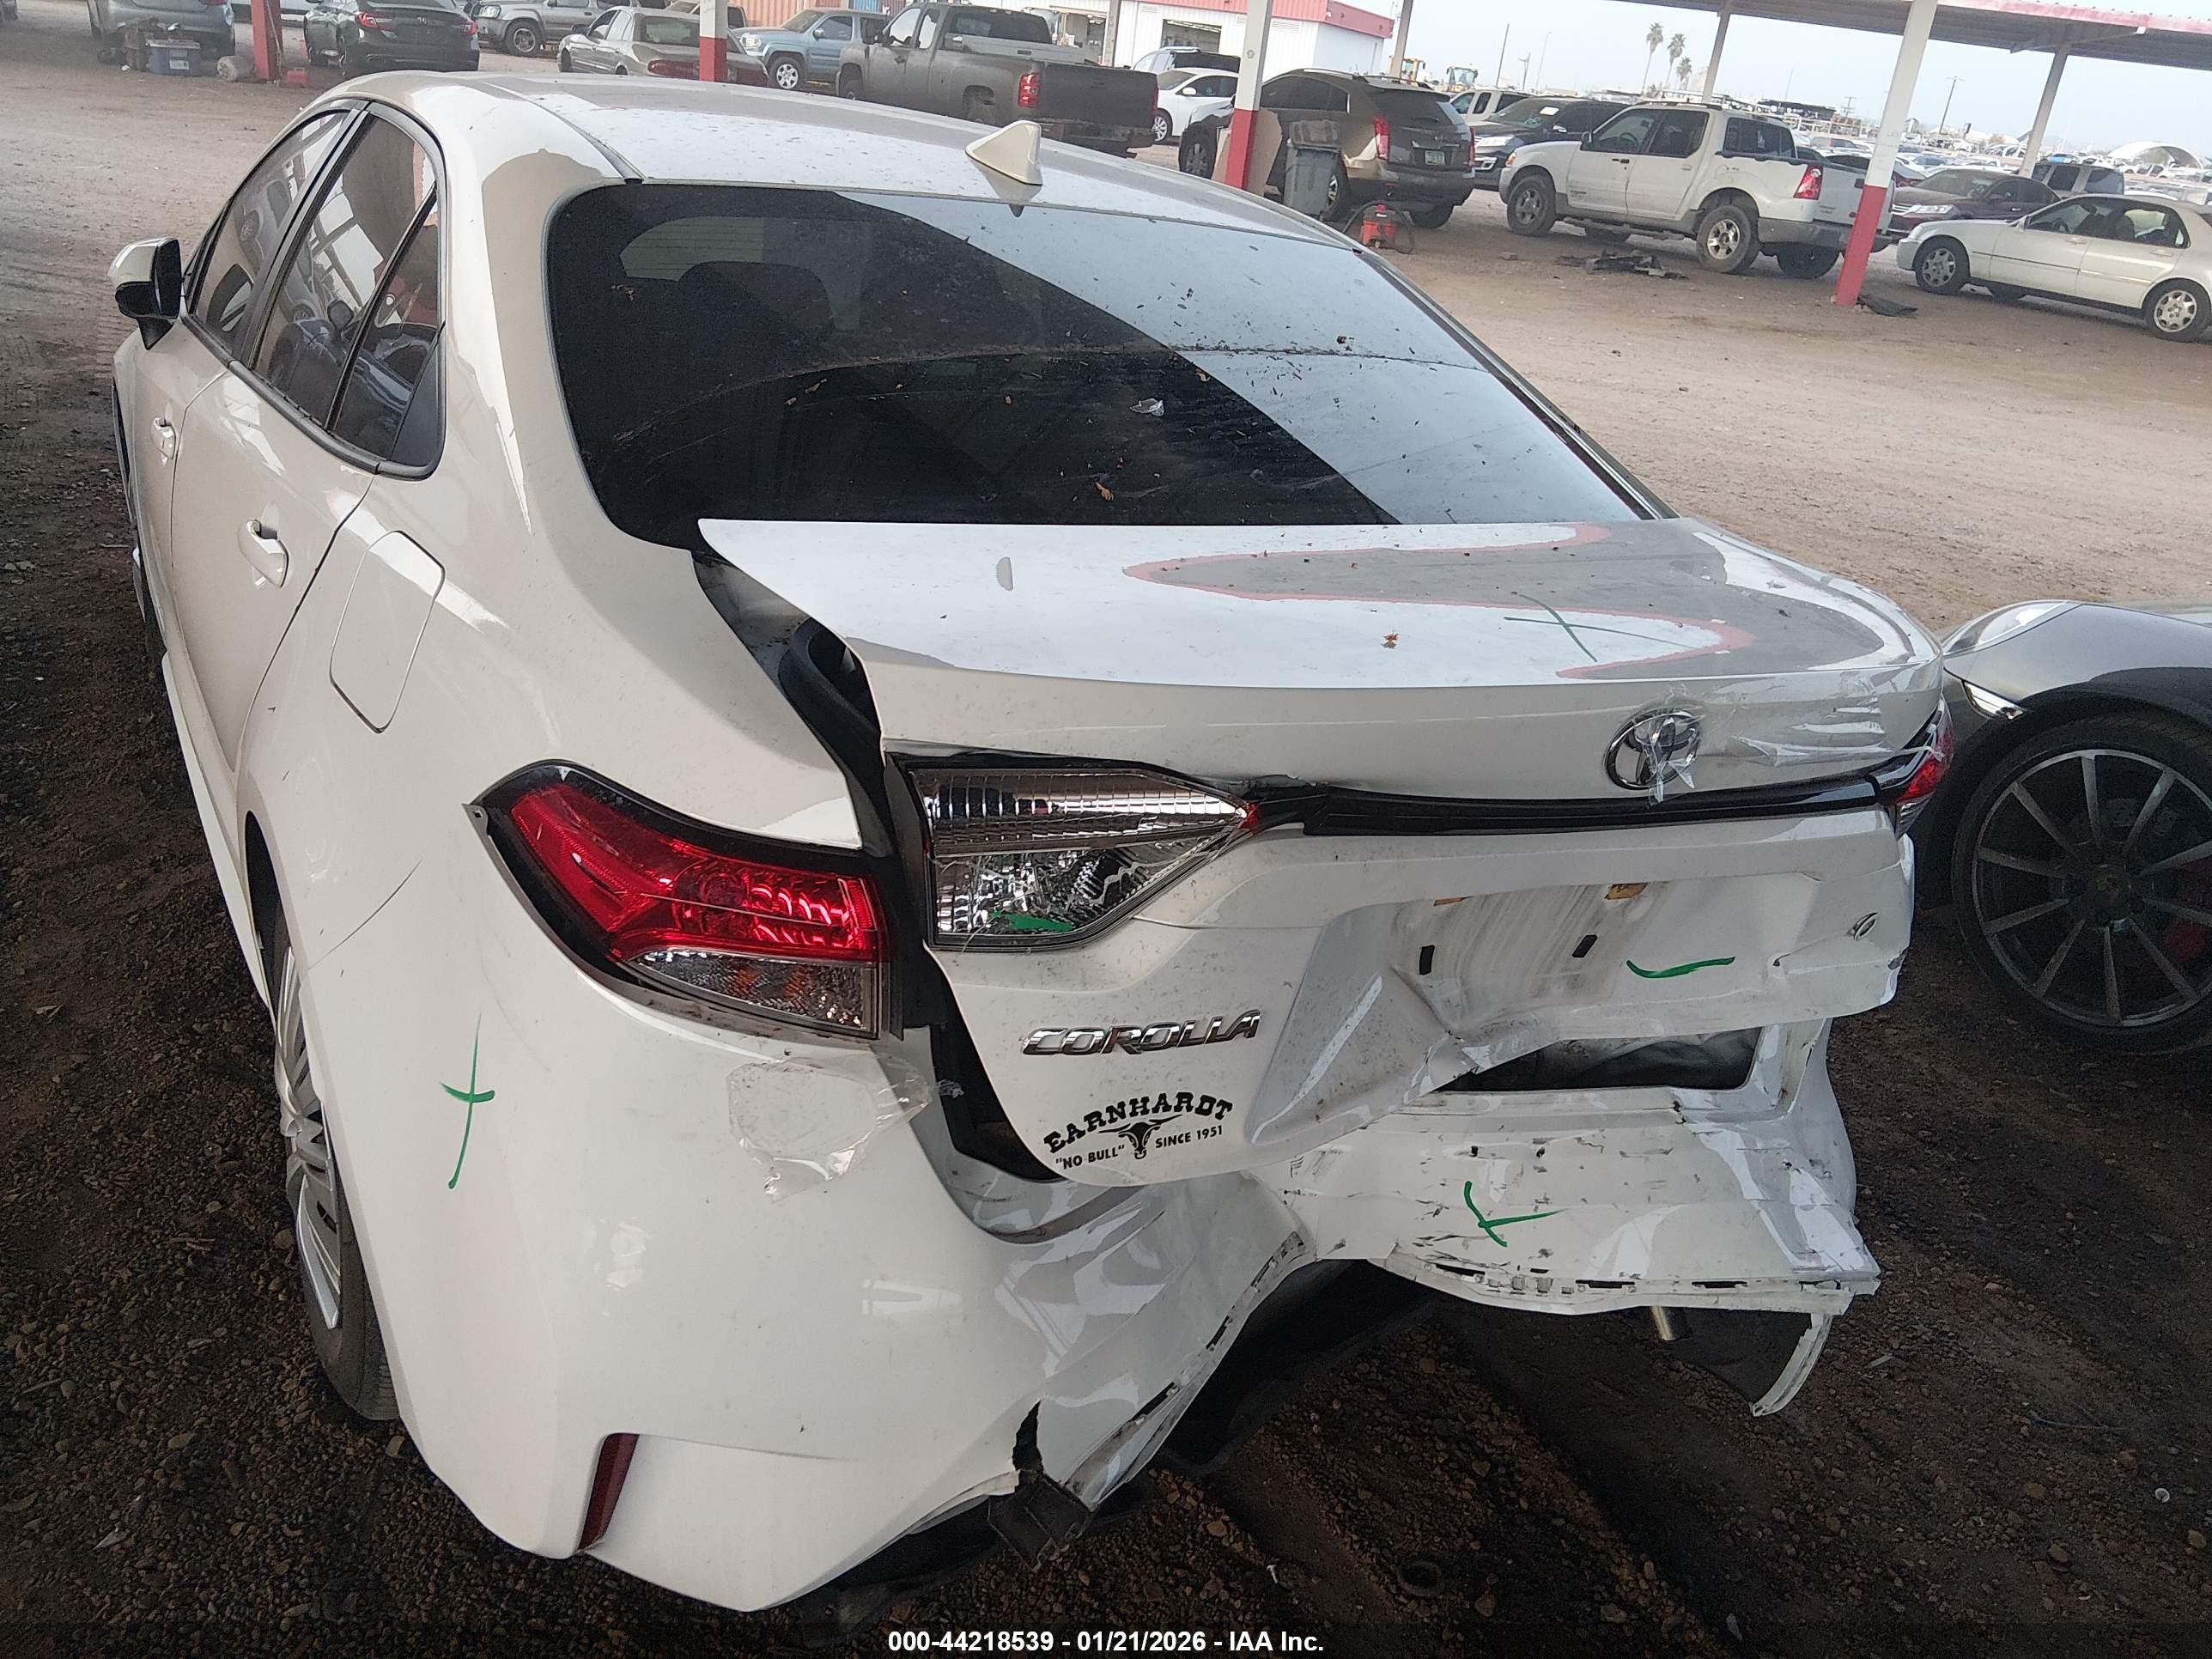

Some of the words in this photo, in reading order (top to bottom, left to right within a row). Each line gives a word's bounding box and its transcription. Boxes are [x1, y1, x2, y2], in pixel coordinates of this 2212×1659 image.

[1023, 1009, 1261, 1055] COROLLA
[1043, 1091, 1233, 1153] EARNHARDT
[1155, 1133, 1191, 1149] SINCE
[1196, 1125, 1224, 1140] 1951
[1055, 1157, 1083, 1170] "NO
[1088, 1145, 1125, 1164] BULL"
